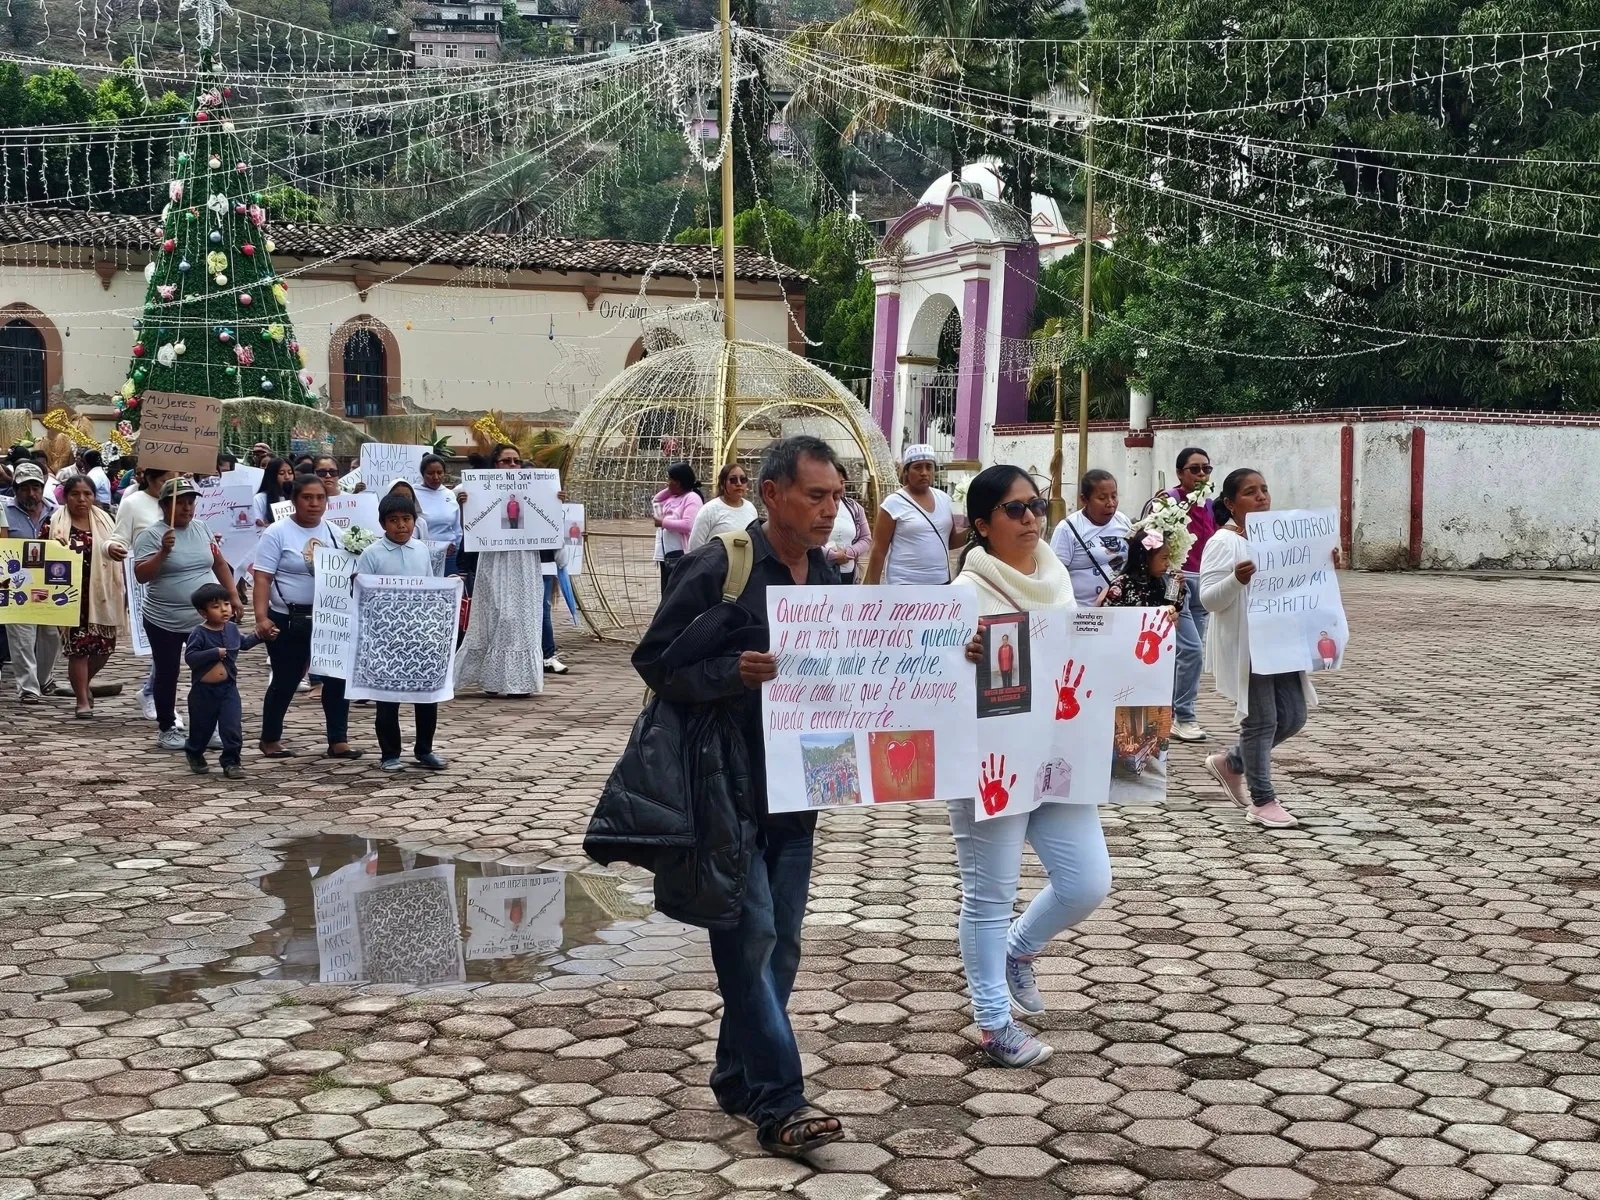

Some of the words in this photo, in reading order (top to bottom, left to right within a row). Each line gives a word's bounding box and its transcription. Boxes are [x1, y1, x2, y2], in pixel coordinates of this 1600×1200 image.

[206, 404, 220, 414] no
[145, 440, 189, 455] ayuda
[380, 444, 408, 460] UNA
[1248, 521, 1268, 543] ME
[1272, 513, 1336, 543] QUITARON
[321, 553, 349, 572] HOY
[1257, 551, 1275, 572] LA
[1280, 545, 1311, 568] VIDA
[378, 577, 425, 586] JUSTICIA
[1251, 574, 1284, 593] PERO
[1288, 573, 1306, 588] NO
[319, 592, 348, 610] VOCES
[841, 603, 854, 622] en
[858, 599, 882, 621] mi
[889, 598, 962, 621] memoria
[1097, 619, 1104, 627] de
[775, 629, 789, 659] y
[794, 629, 811, 649] en
[815, 626, 839, 650] mis
[797, 650, 833, 676] donde
[836, 649, 867, 676] nadie
[871, 650, 890, 675] te
[768, 676, 808, 703] donde
[809, 678, 836, 702] cada
[839, 682, 856, 702] vez
[860, 682, 883, 708] que
[888, 676, 906, 700] te
[769, 704, 804, 737] pueda
